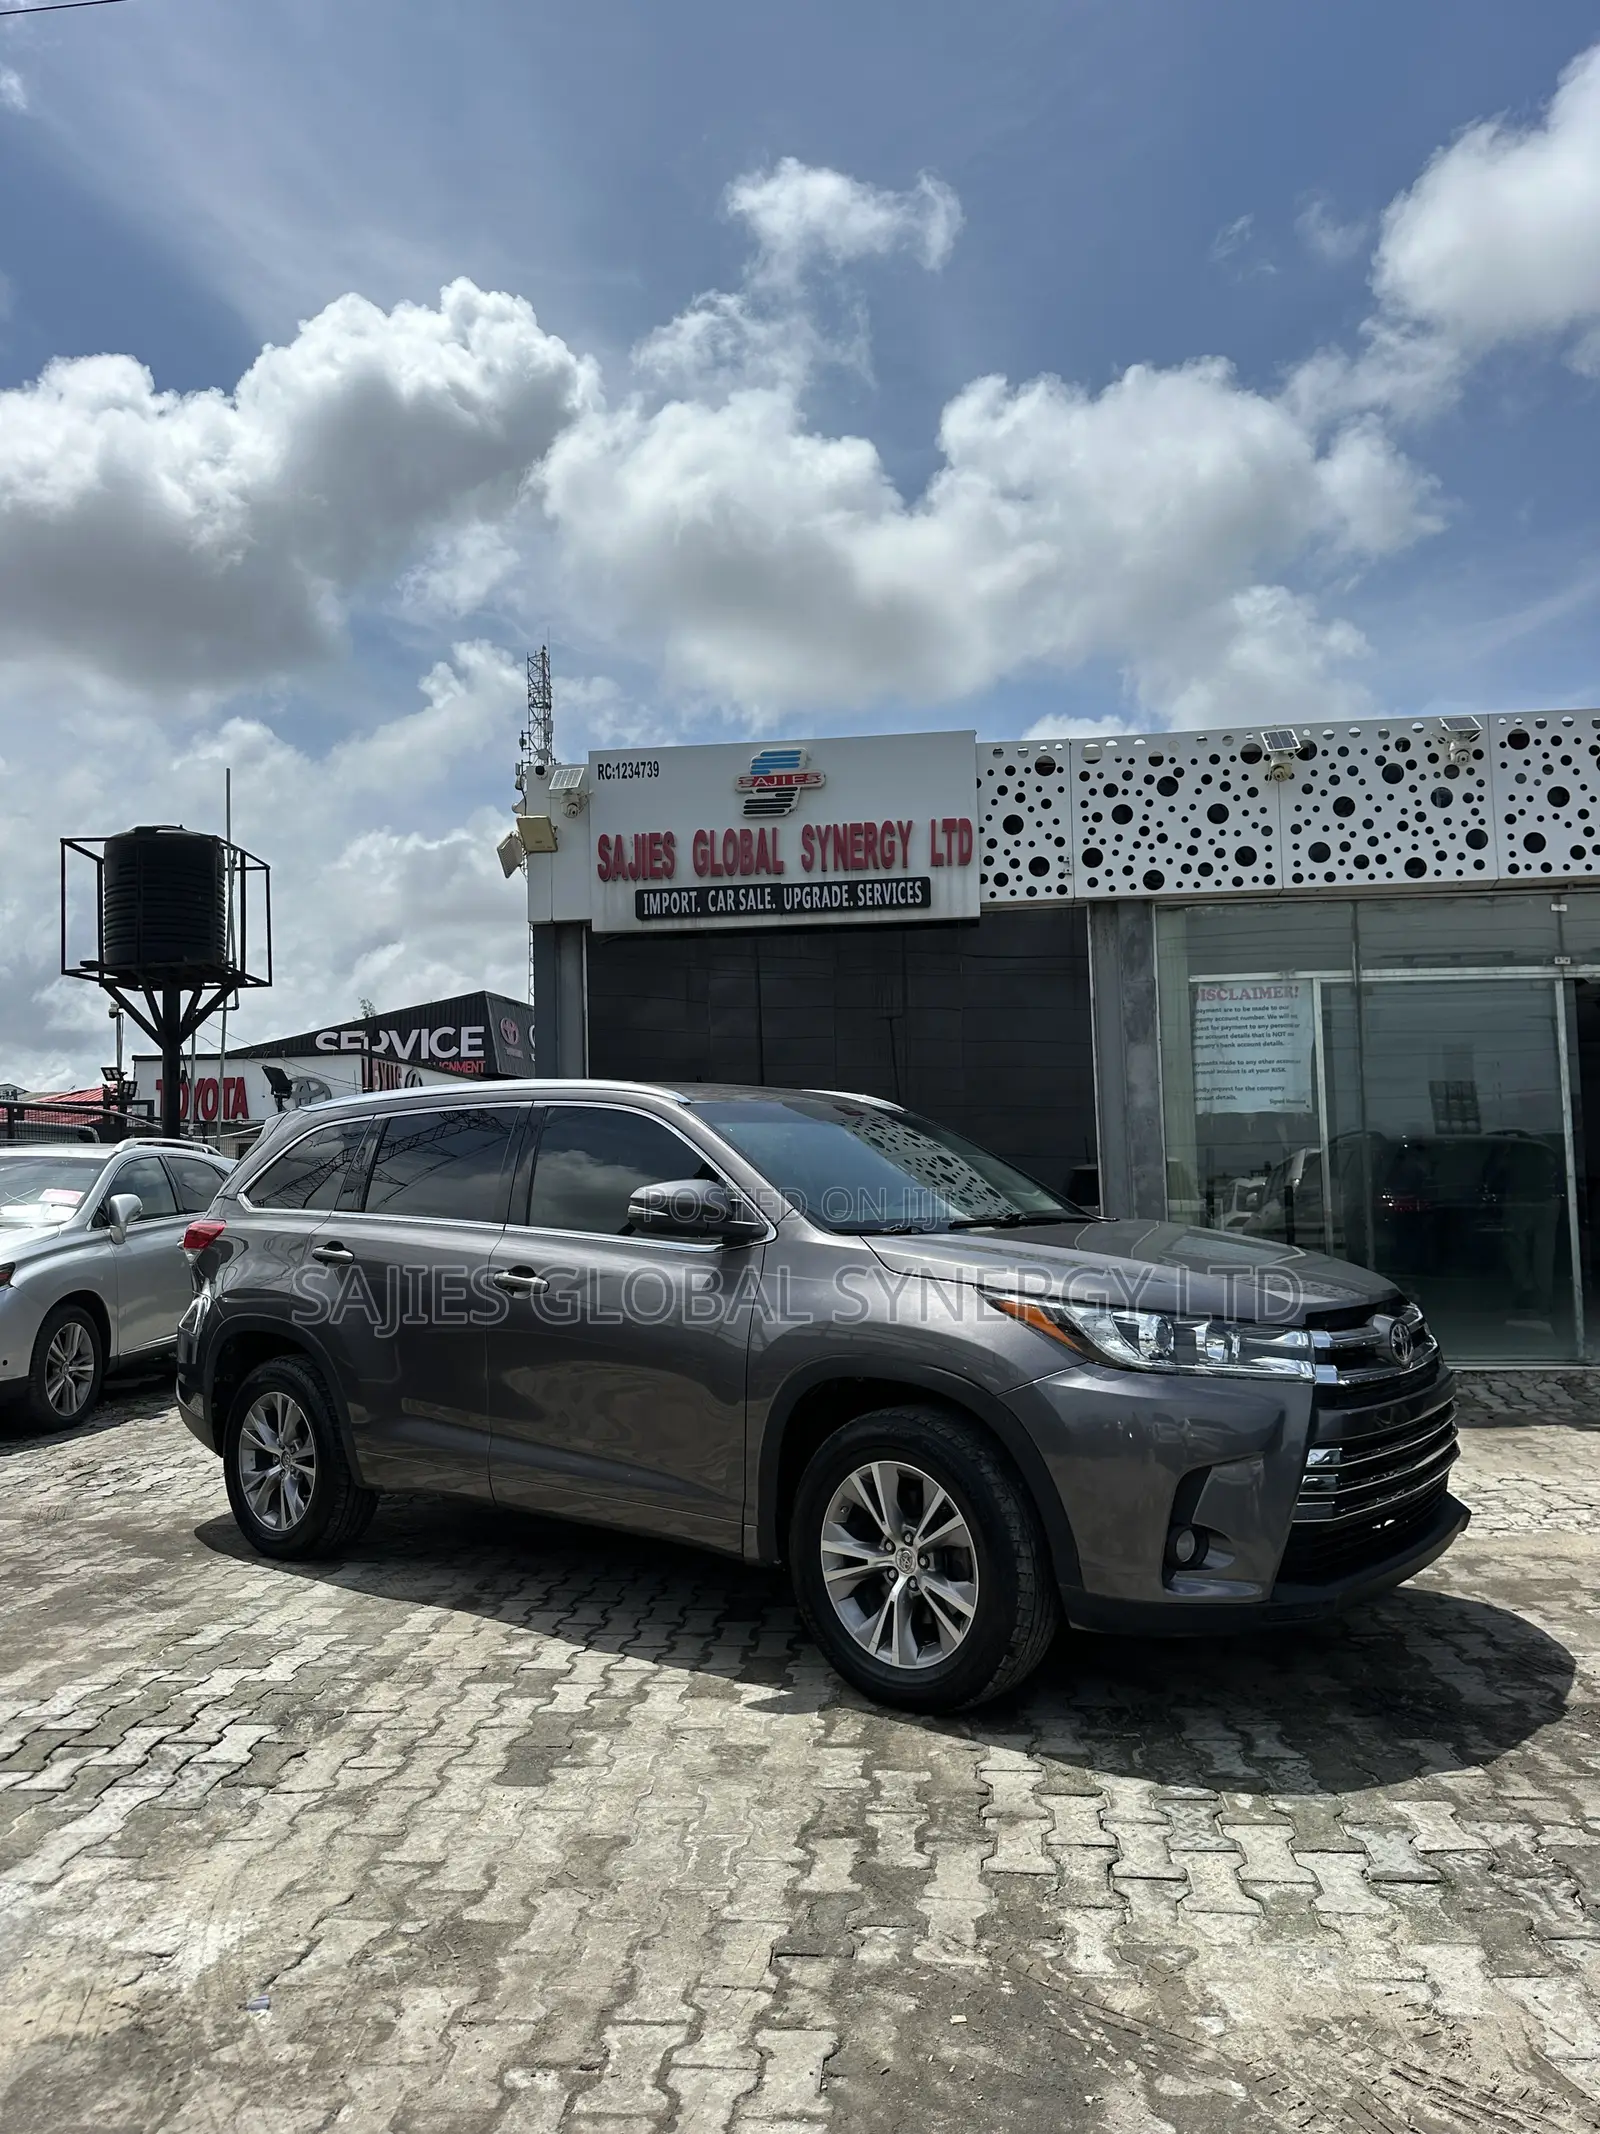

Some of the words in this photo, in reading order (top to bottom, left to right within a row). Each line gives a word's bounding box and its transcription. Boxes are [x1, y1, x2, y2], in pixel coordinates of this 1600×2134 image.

[597, 760, 660, 780] RC:1234739
[738, 772, 822, 787] SAJIES
[597, 831, 676, 882] SAJIES
[692, 826, 785, 878] GLOBAL
[800, 820, 914, 873] SYNERGY
[930, 817, 974, 868] LTD
[643, 891, 701, 915] IMPORT.
[707, 889, 738, 912] CAR
[739, 887, 776, 911] SALE.
[783, 884, 854, 910] UPGRADE.
[857, 881, 923, 906] SERVICES
[428, 1060, 486, 1073] GNMENT
